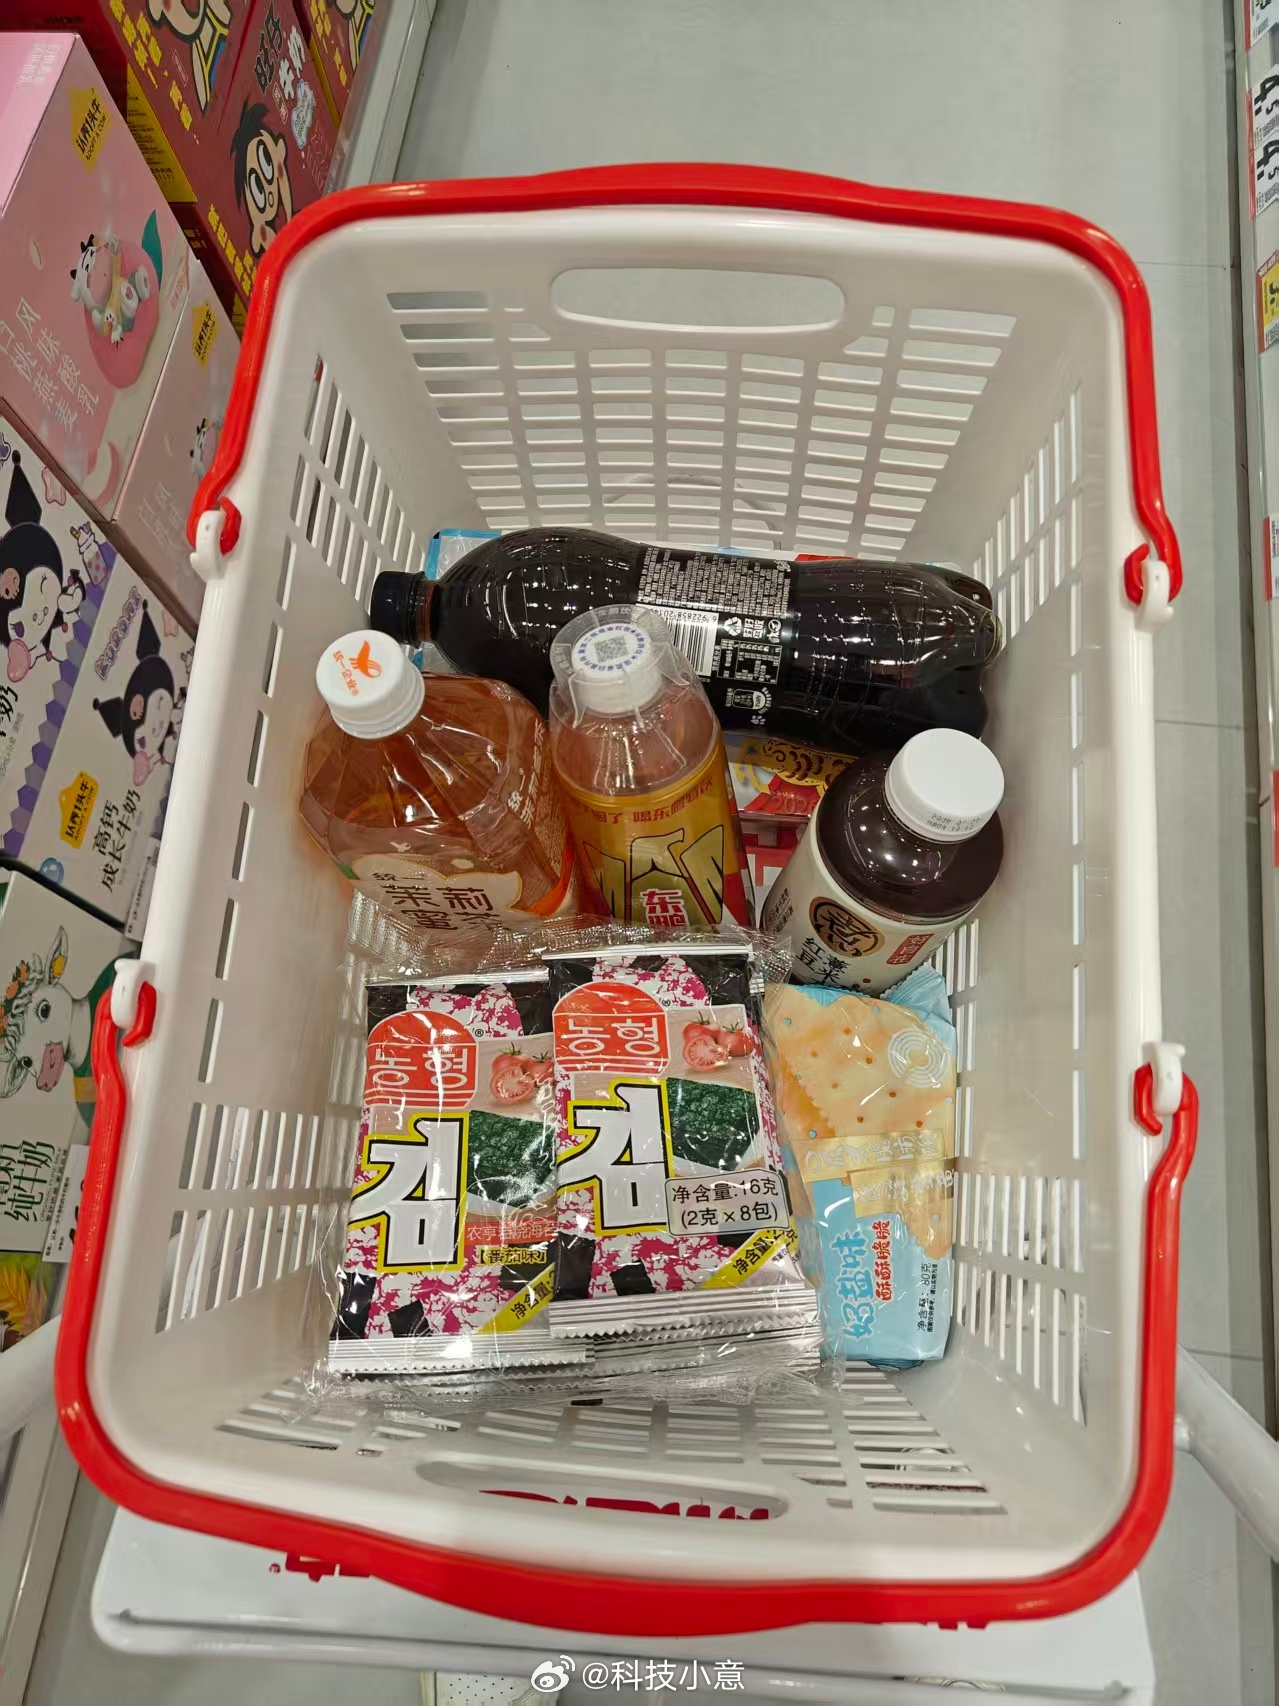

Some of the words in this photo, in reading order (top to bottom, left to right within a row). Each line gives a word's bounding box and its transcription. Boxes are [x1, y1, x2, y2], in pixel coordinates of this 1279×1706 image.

[92, 800, 120, 856] 高钙
[100, 789, 141, 894] 成长牛奶
[381, 884, 493, 911] 茉莉
[1, 1140, 55, 1221] 纯牛奶
[671, 1176, 780, 1206] 净含量:16克
[832, 1232, 873, 1338] 好盐味
[872, 1220, 892, 1301] 酥酥脆脆
